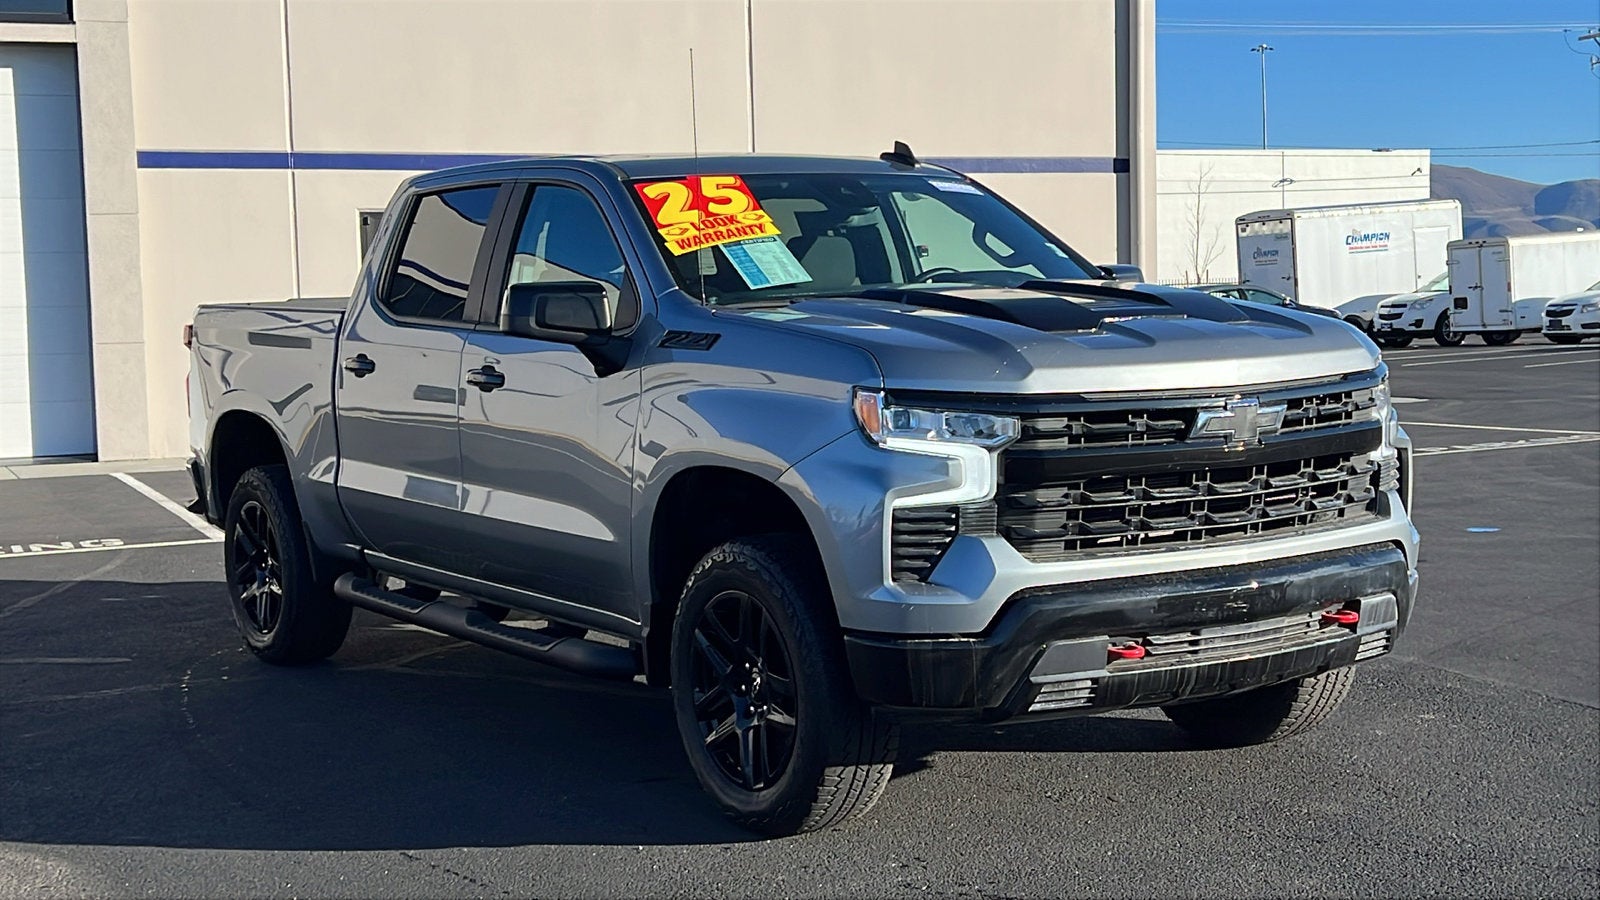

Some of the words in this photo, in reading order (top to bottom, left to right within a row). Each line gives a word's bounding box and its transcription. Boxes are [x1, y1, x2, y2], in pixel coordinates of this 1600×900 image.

[643, 176, 753, 225] 25
[689, 215, 742, 231] LOOK
[675, 223, 766, 250] WARRANTY
[1345, 232, 1390, 246] CHAMPION
[0, 538, 124, 554] ING
